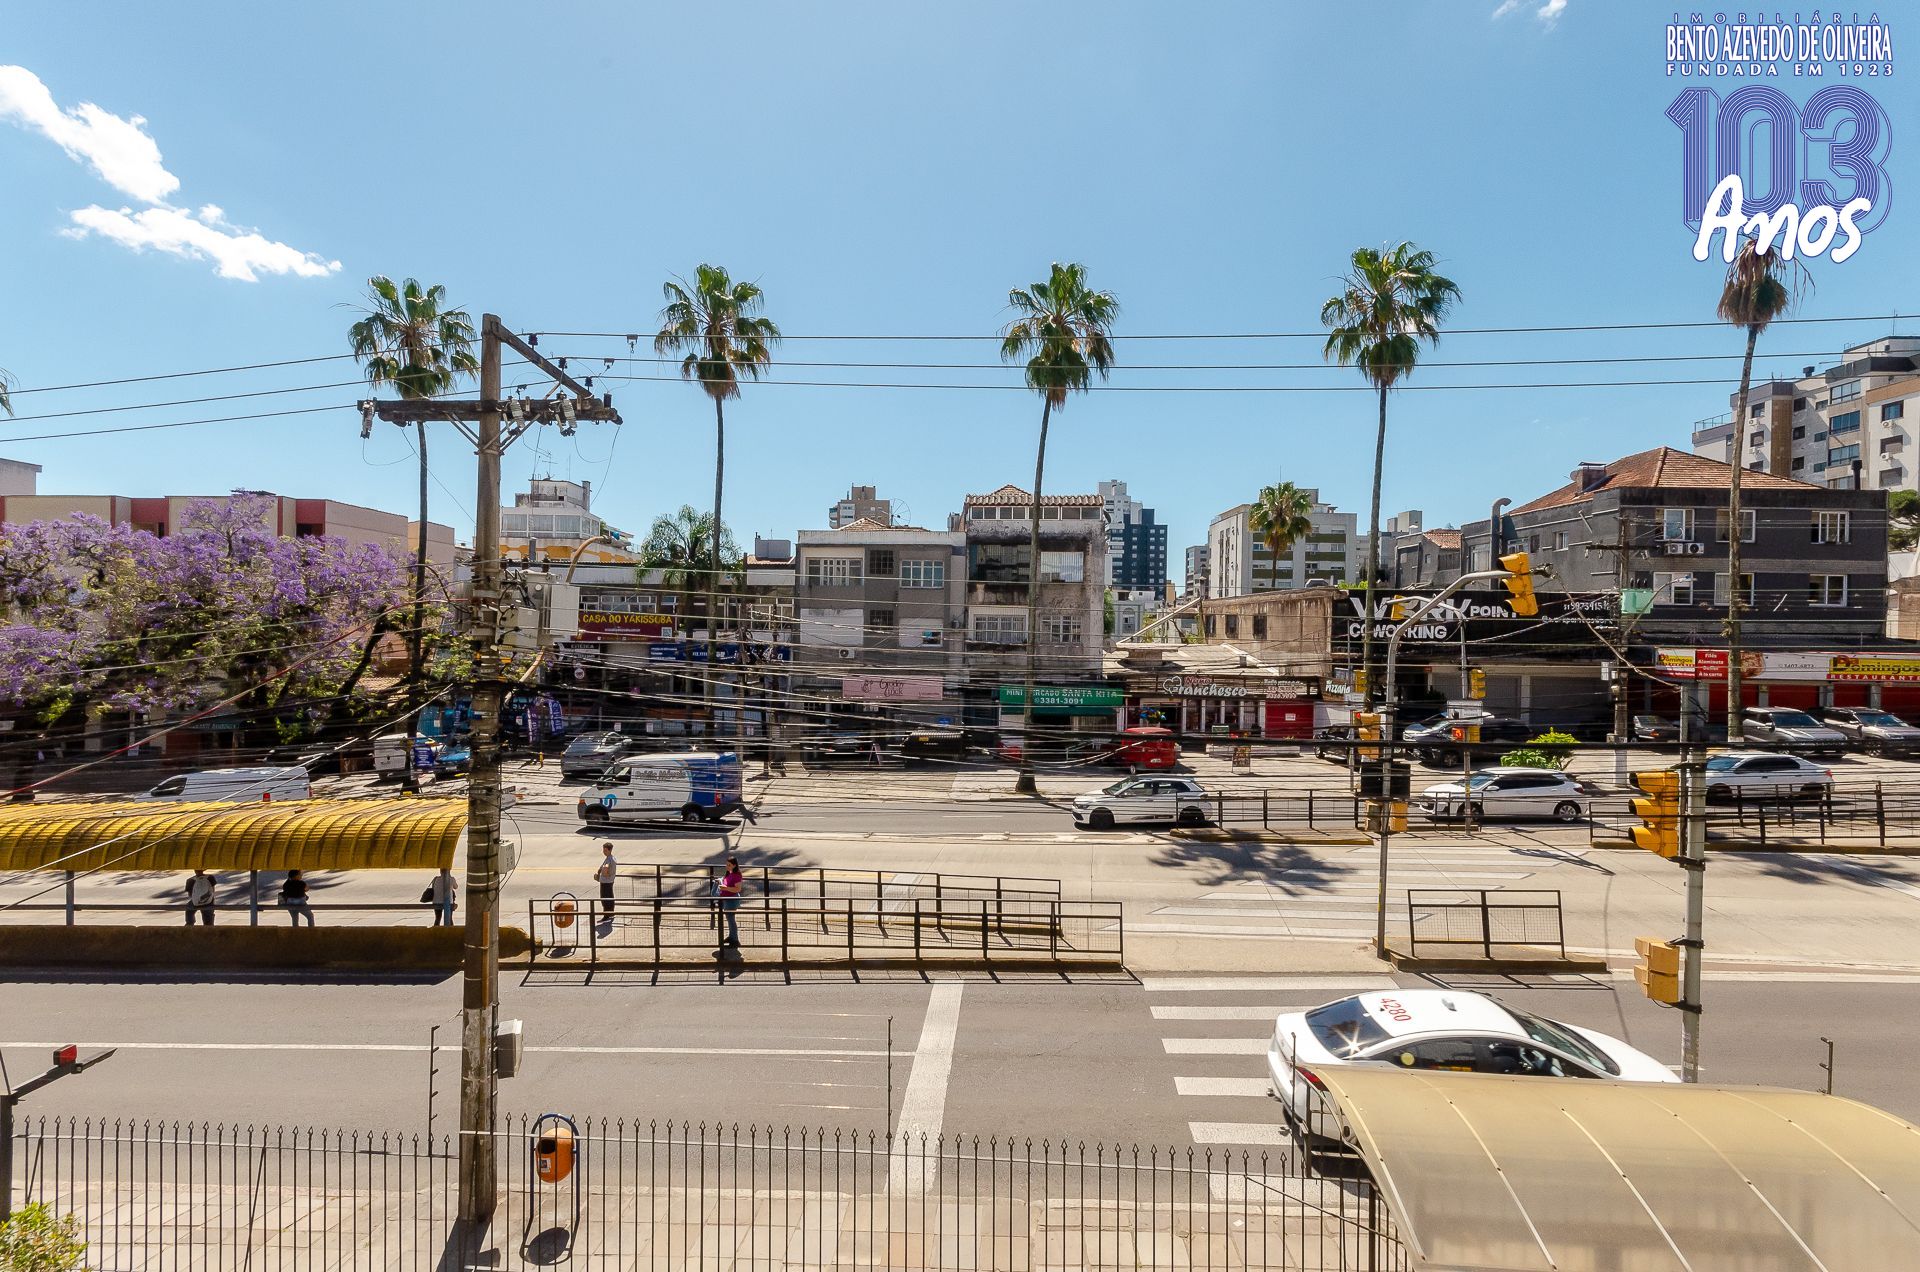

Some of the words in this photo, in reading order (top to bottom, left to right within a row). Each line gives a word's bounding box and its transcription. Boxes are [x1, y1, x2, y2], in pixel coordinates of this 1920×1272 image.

[1470, 605, 1517, 618] POIN
[582, 614, 607, 623] CASA
[608, 614, 621, 623] DO
[1349, 622, 1447, 639] CWOKING
[1030, 689, 1060, 697] ERCADO
[1061, 688, 1093, 698] SANTA
[1040, 697, 1084, 705] 3381-3091
[1380, 998, 1412, 1021] 4280
